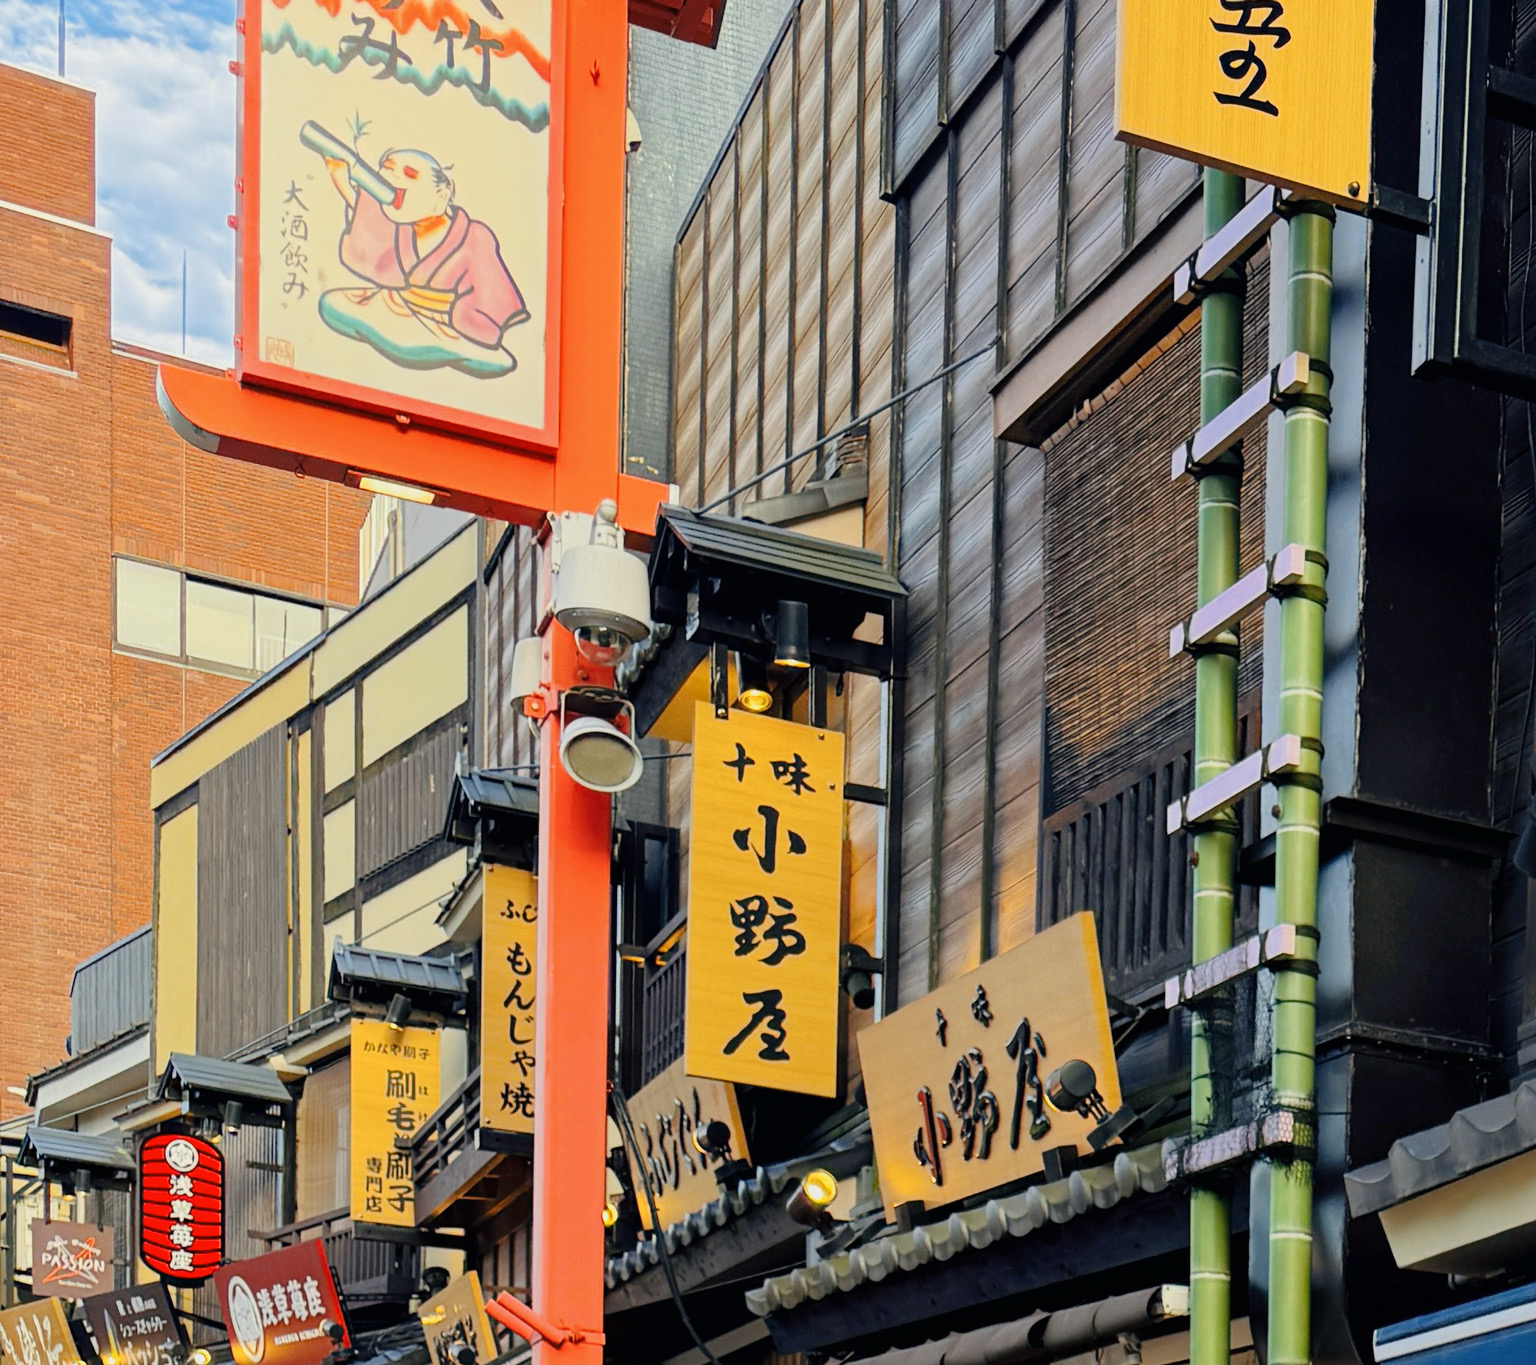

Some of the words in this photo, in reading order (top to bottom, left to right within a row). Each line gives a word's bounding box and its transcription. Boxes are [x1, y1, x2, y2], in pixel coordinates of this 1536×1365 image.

[338, 0, 413, 81] み
[723, 743, 816, 796] 十味
[723, 804, 807, 1062] 小野屋
[913, 1017, 1051, 1187] 小野屋
[41, 1251, 105, 1273] PASSION
[169, 1174, 195, 1272] 浅草苺座
[256, 1275, 327, 1328] 浅草苺座
